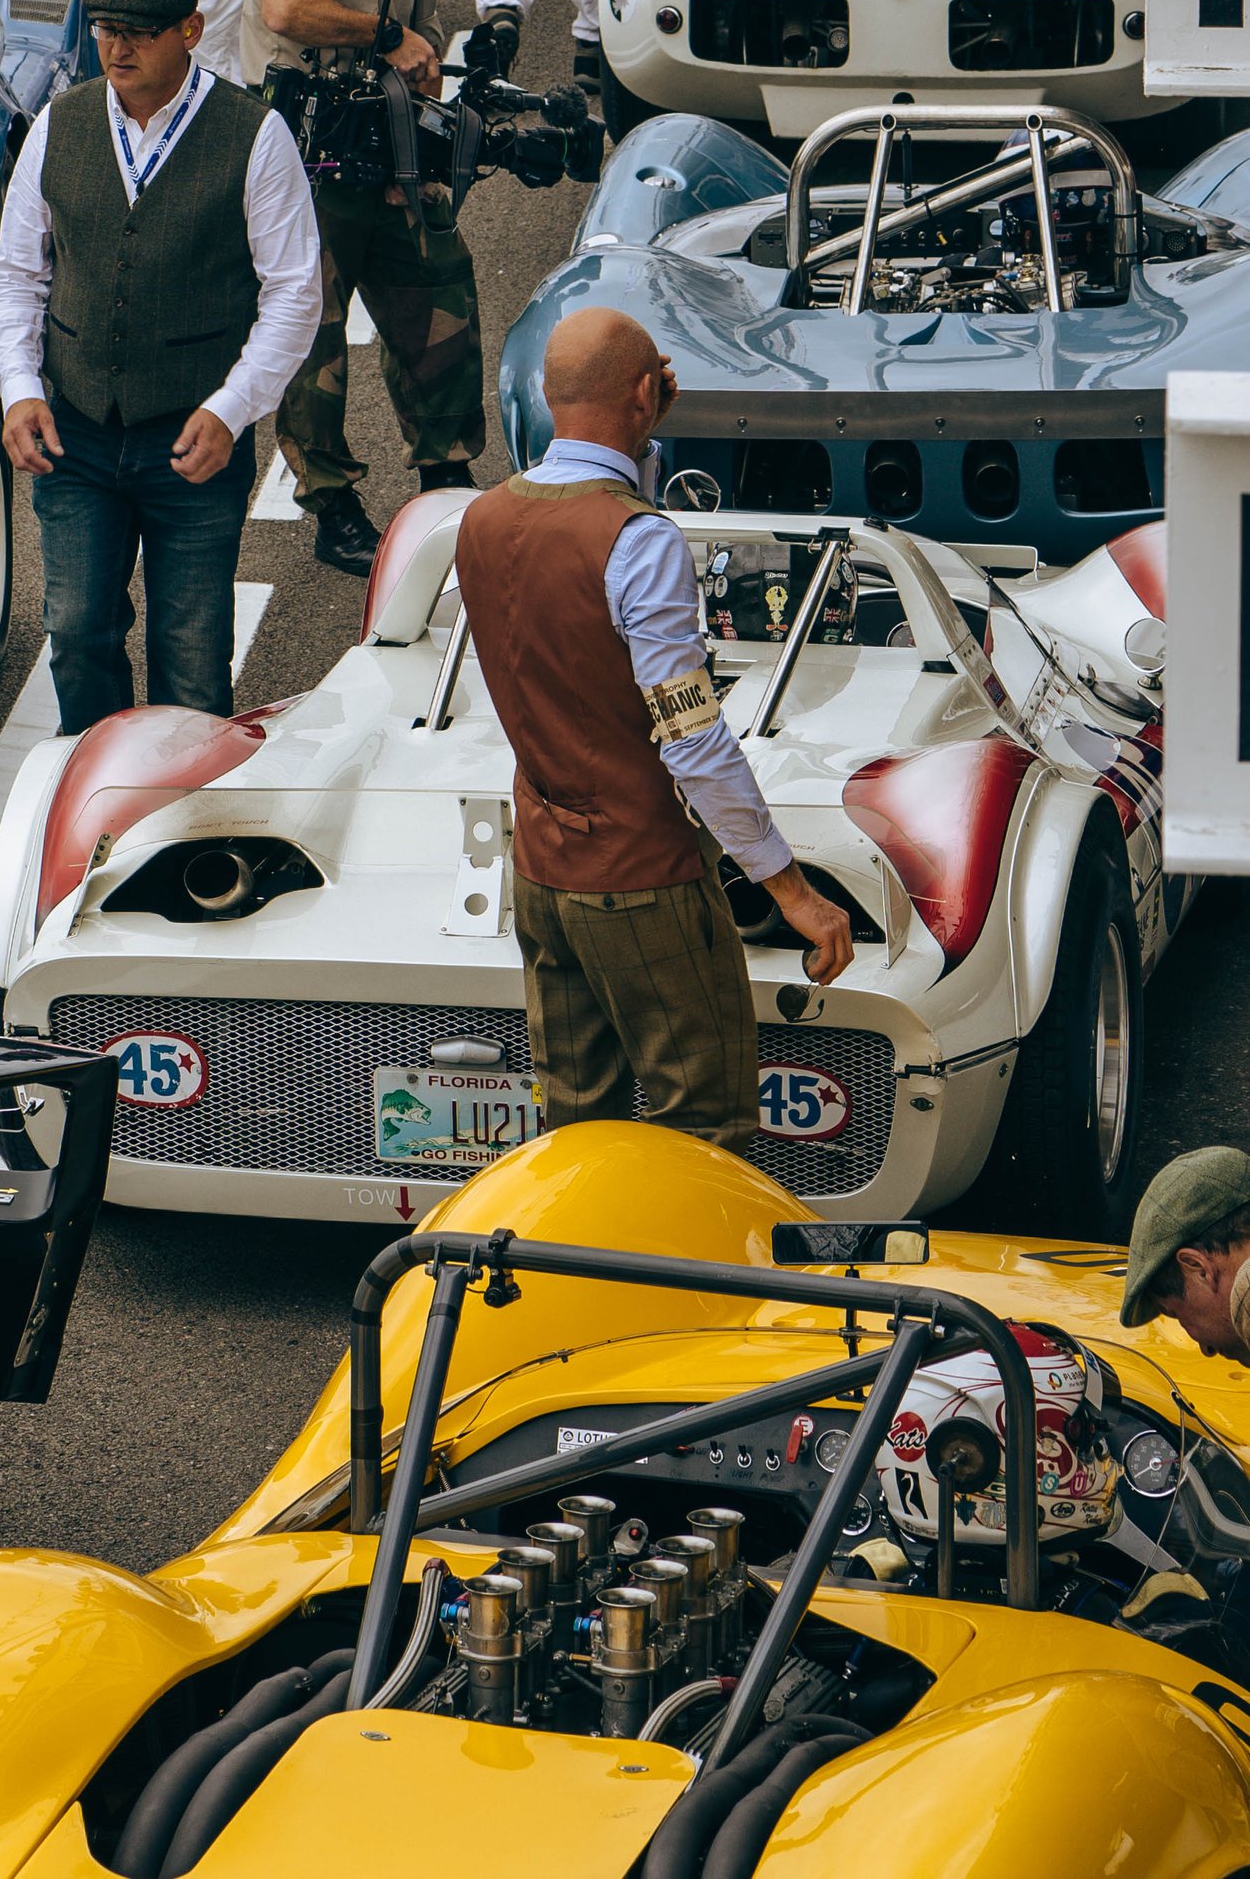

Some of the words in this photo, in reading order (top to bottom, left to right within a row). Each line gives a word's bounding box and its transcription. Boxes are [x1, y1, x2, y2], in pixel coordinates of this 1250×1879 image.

[118, 1042, 181, 1097] 45
[428, 1075, 512, 1091] FLORIDA
[758, 1072, 822, 1129] 45
[421, 1149, 447, 1160] GO
[342, 1187, 396, 1206] TOW
